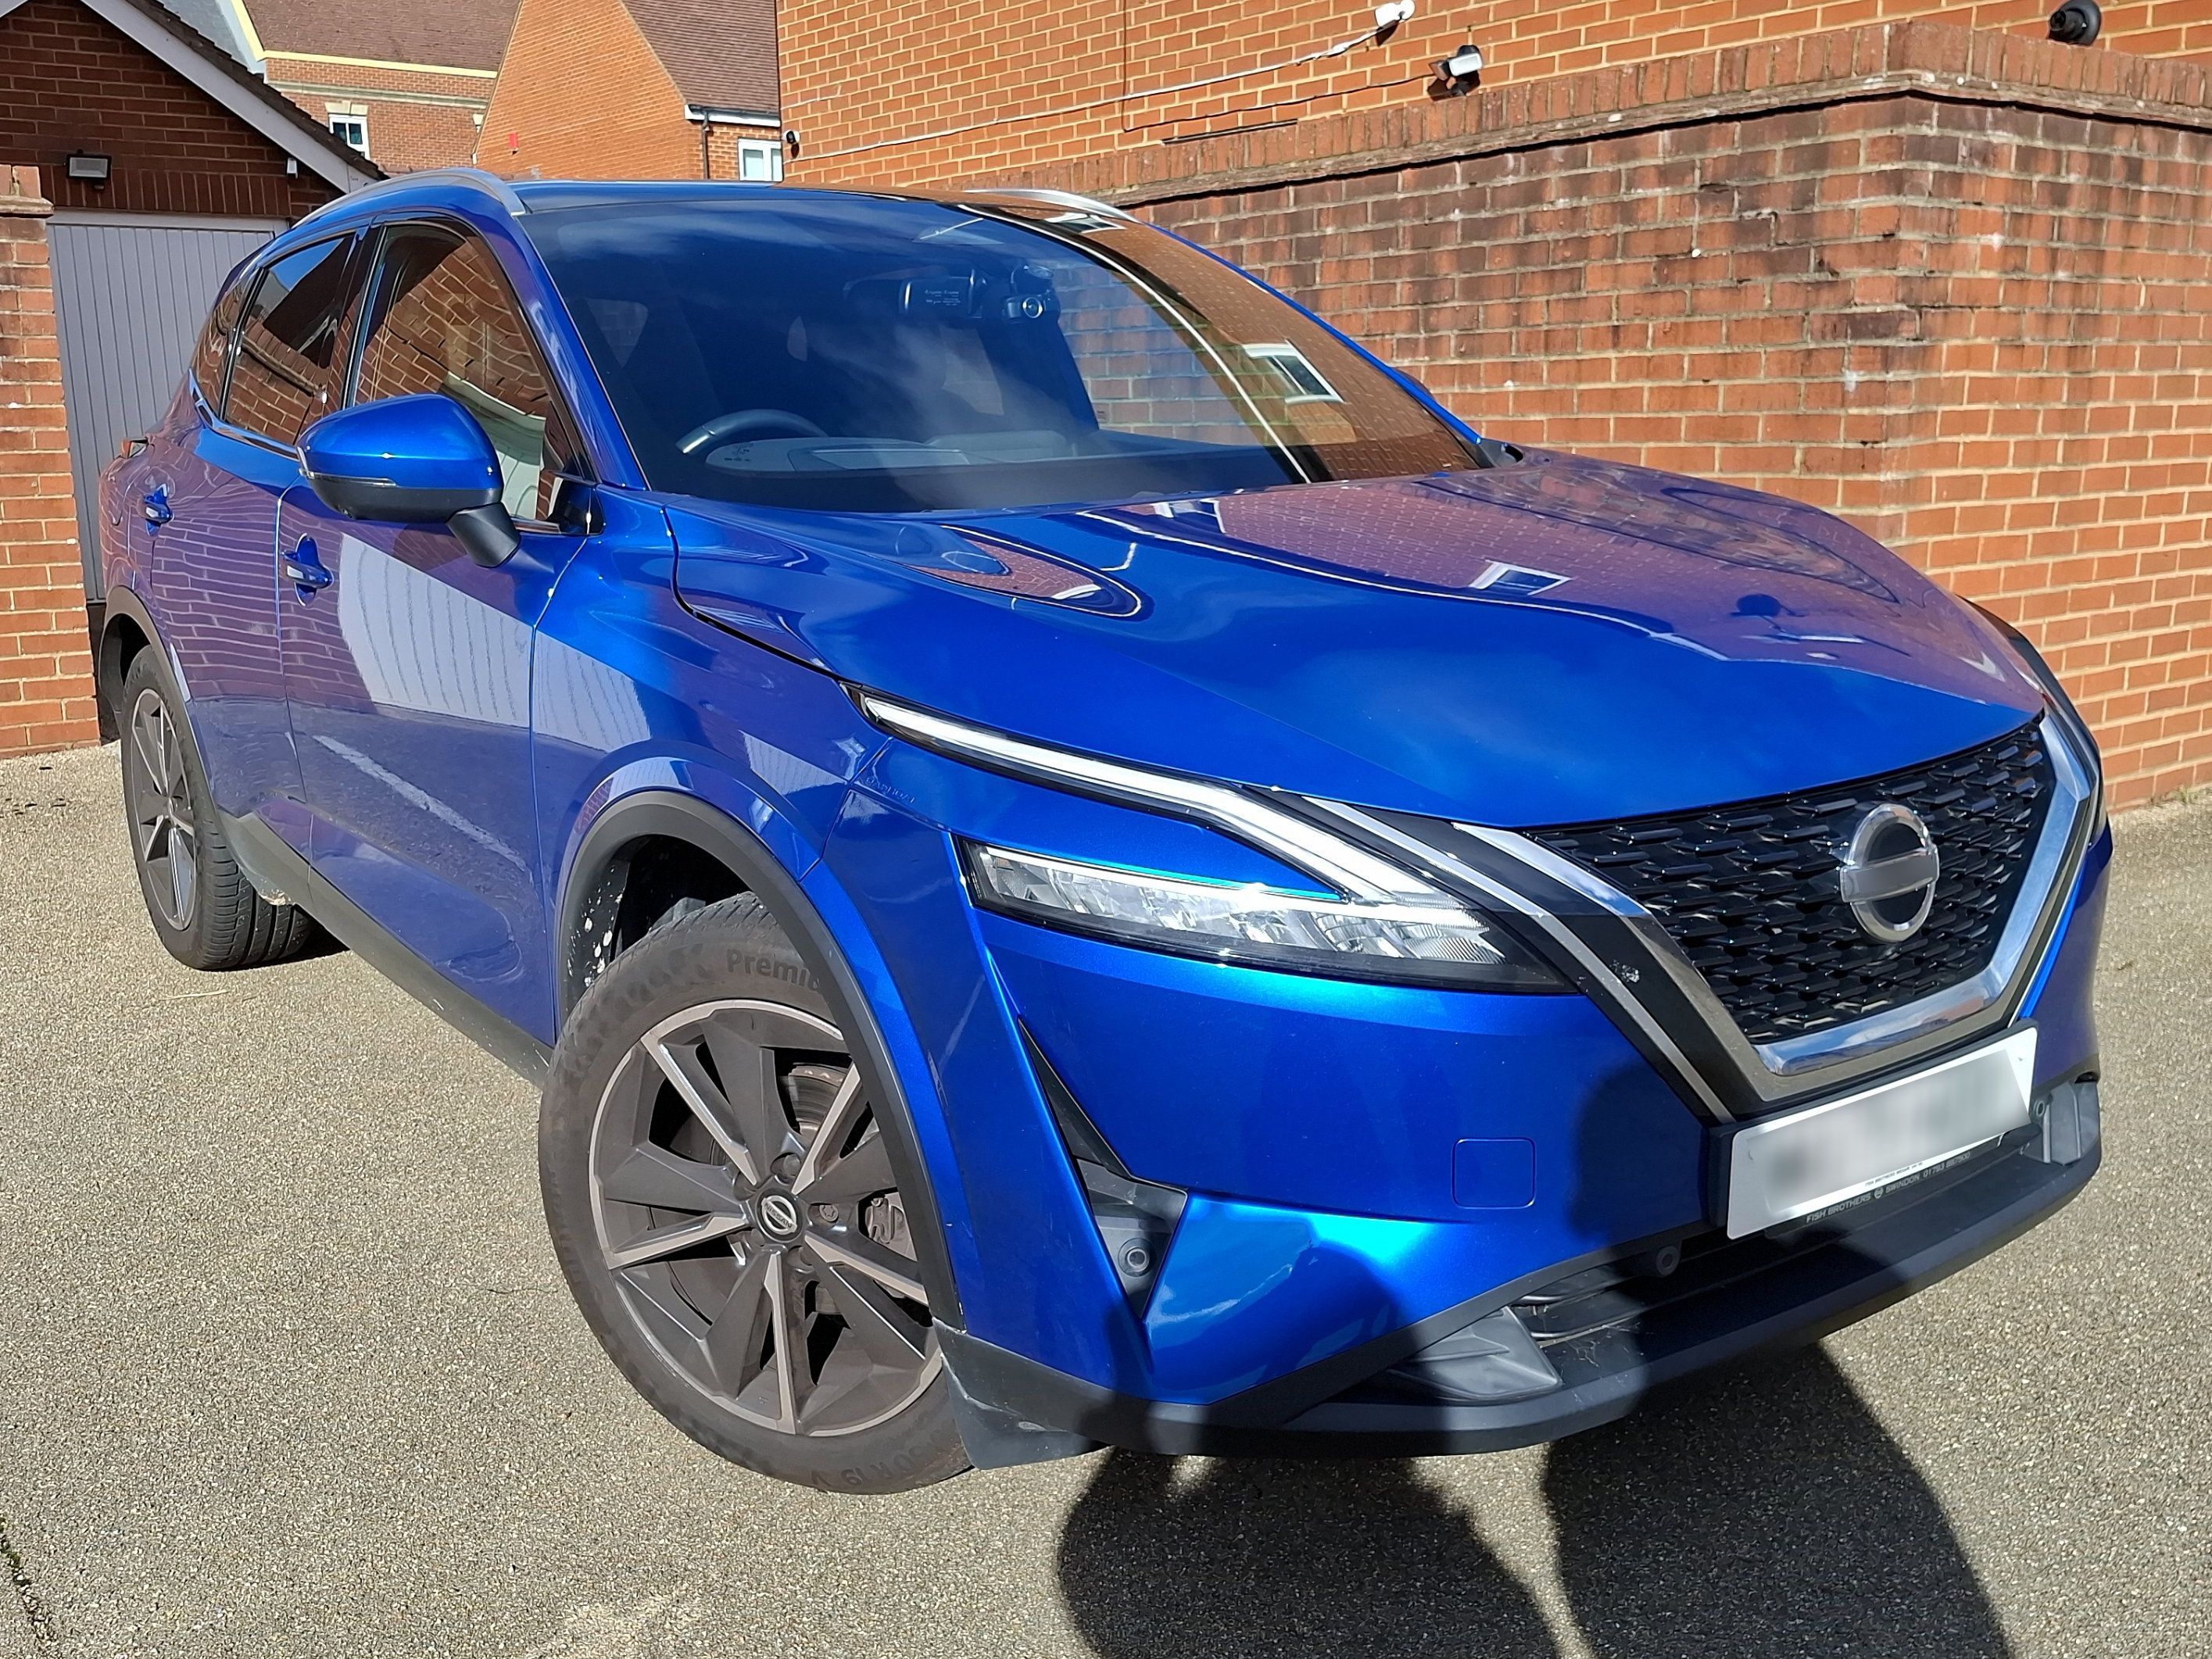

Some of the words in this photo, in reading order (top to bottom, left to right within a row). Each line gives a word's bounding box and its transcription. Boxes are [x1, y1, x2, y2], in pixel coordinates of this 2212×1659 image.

[764, 1203, 793, 1229] NISSAN
[1806, 1209, 1827, 1224] FISH
[1827, 1194, 1871, 1215] BROTHERS
